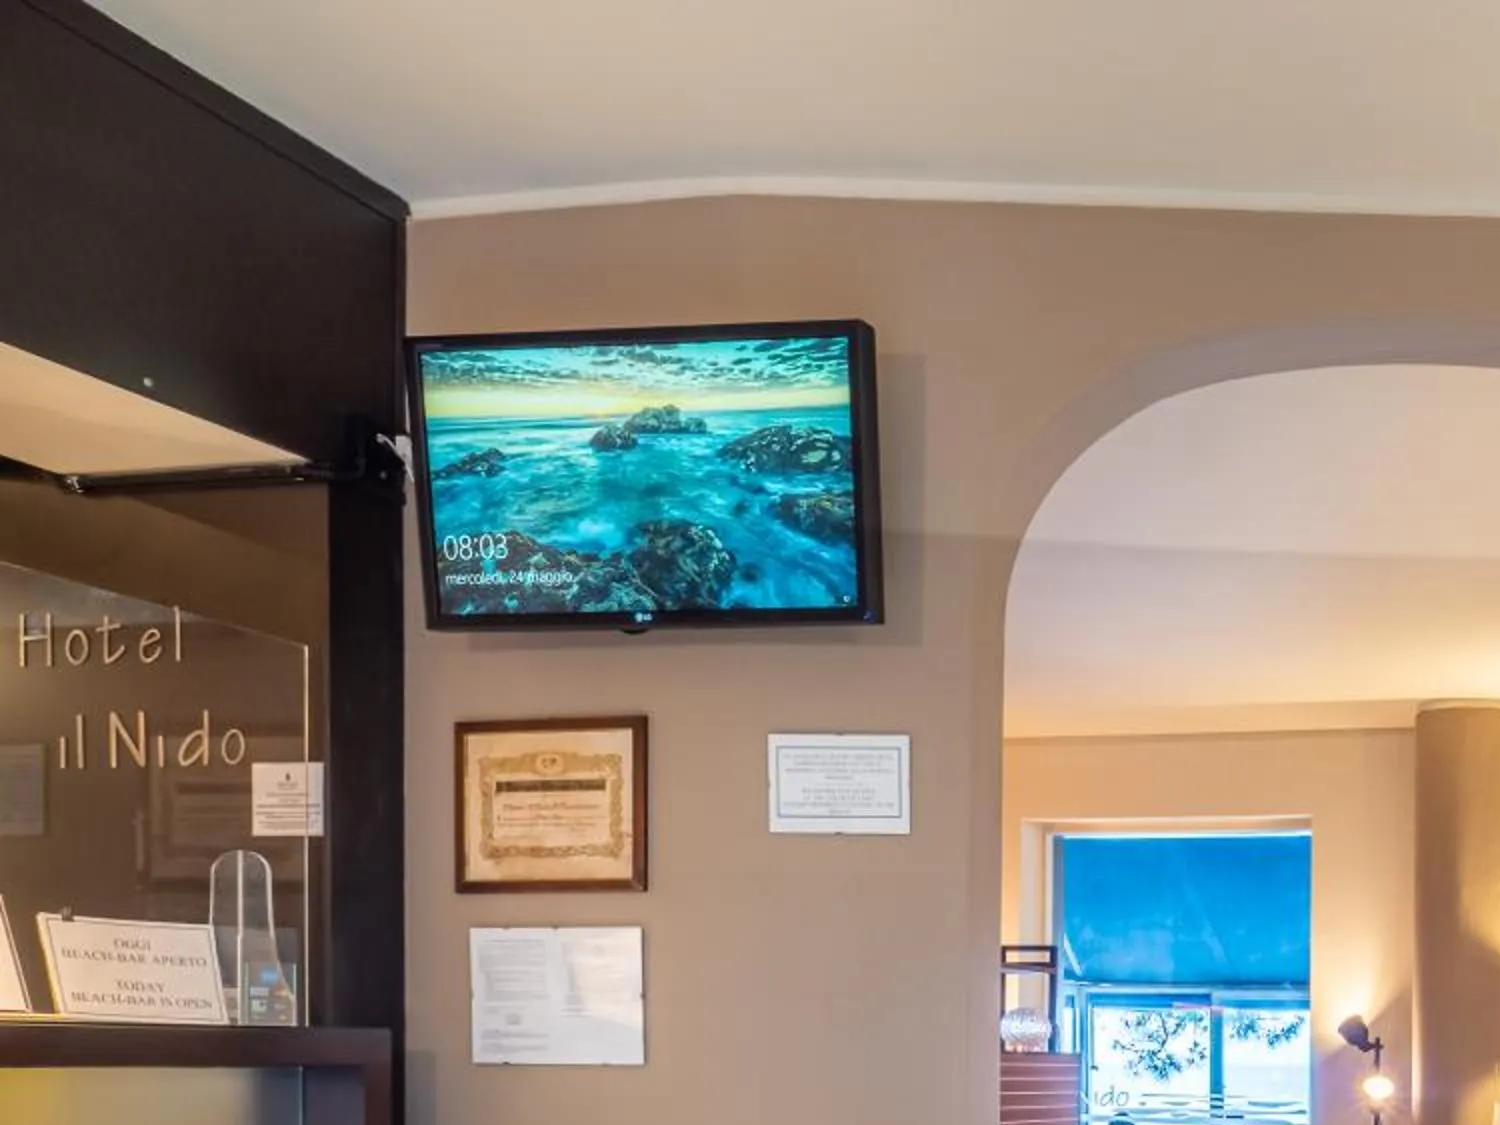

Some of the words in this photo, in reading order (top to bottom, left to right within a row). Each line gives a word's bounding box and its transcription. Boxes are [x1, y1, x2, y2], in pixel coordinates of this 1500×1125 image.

[443, 534, 508, 561] 08:03
[509, 569, 524, 584] 24
[526, 569, 572, 588] maggio
[19, 605, 183, 667] Hotel
[59, 713, 83, 769] il
[110, 709, 246, 769] Nido
[113, 938, 151, 951] OGGI
[152, 953, 207, 968] APERTO
[116, 979, 165, 993] TODAY
[175, 998, 213, 1010] OPEN
